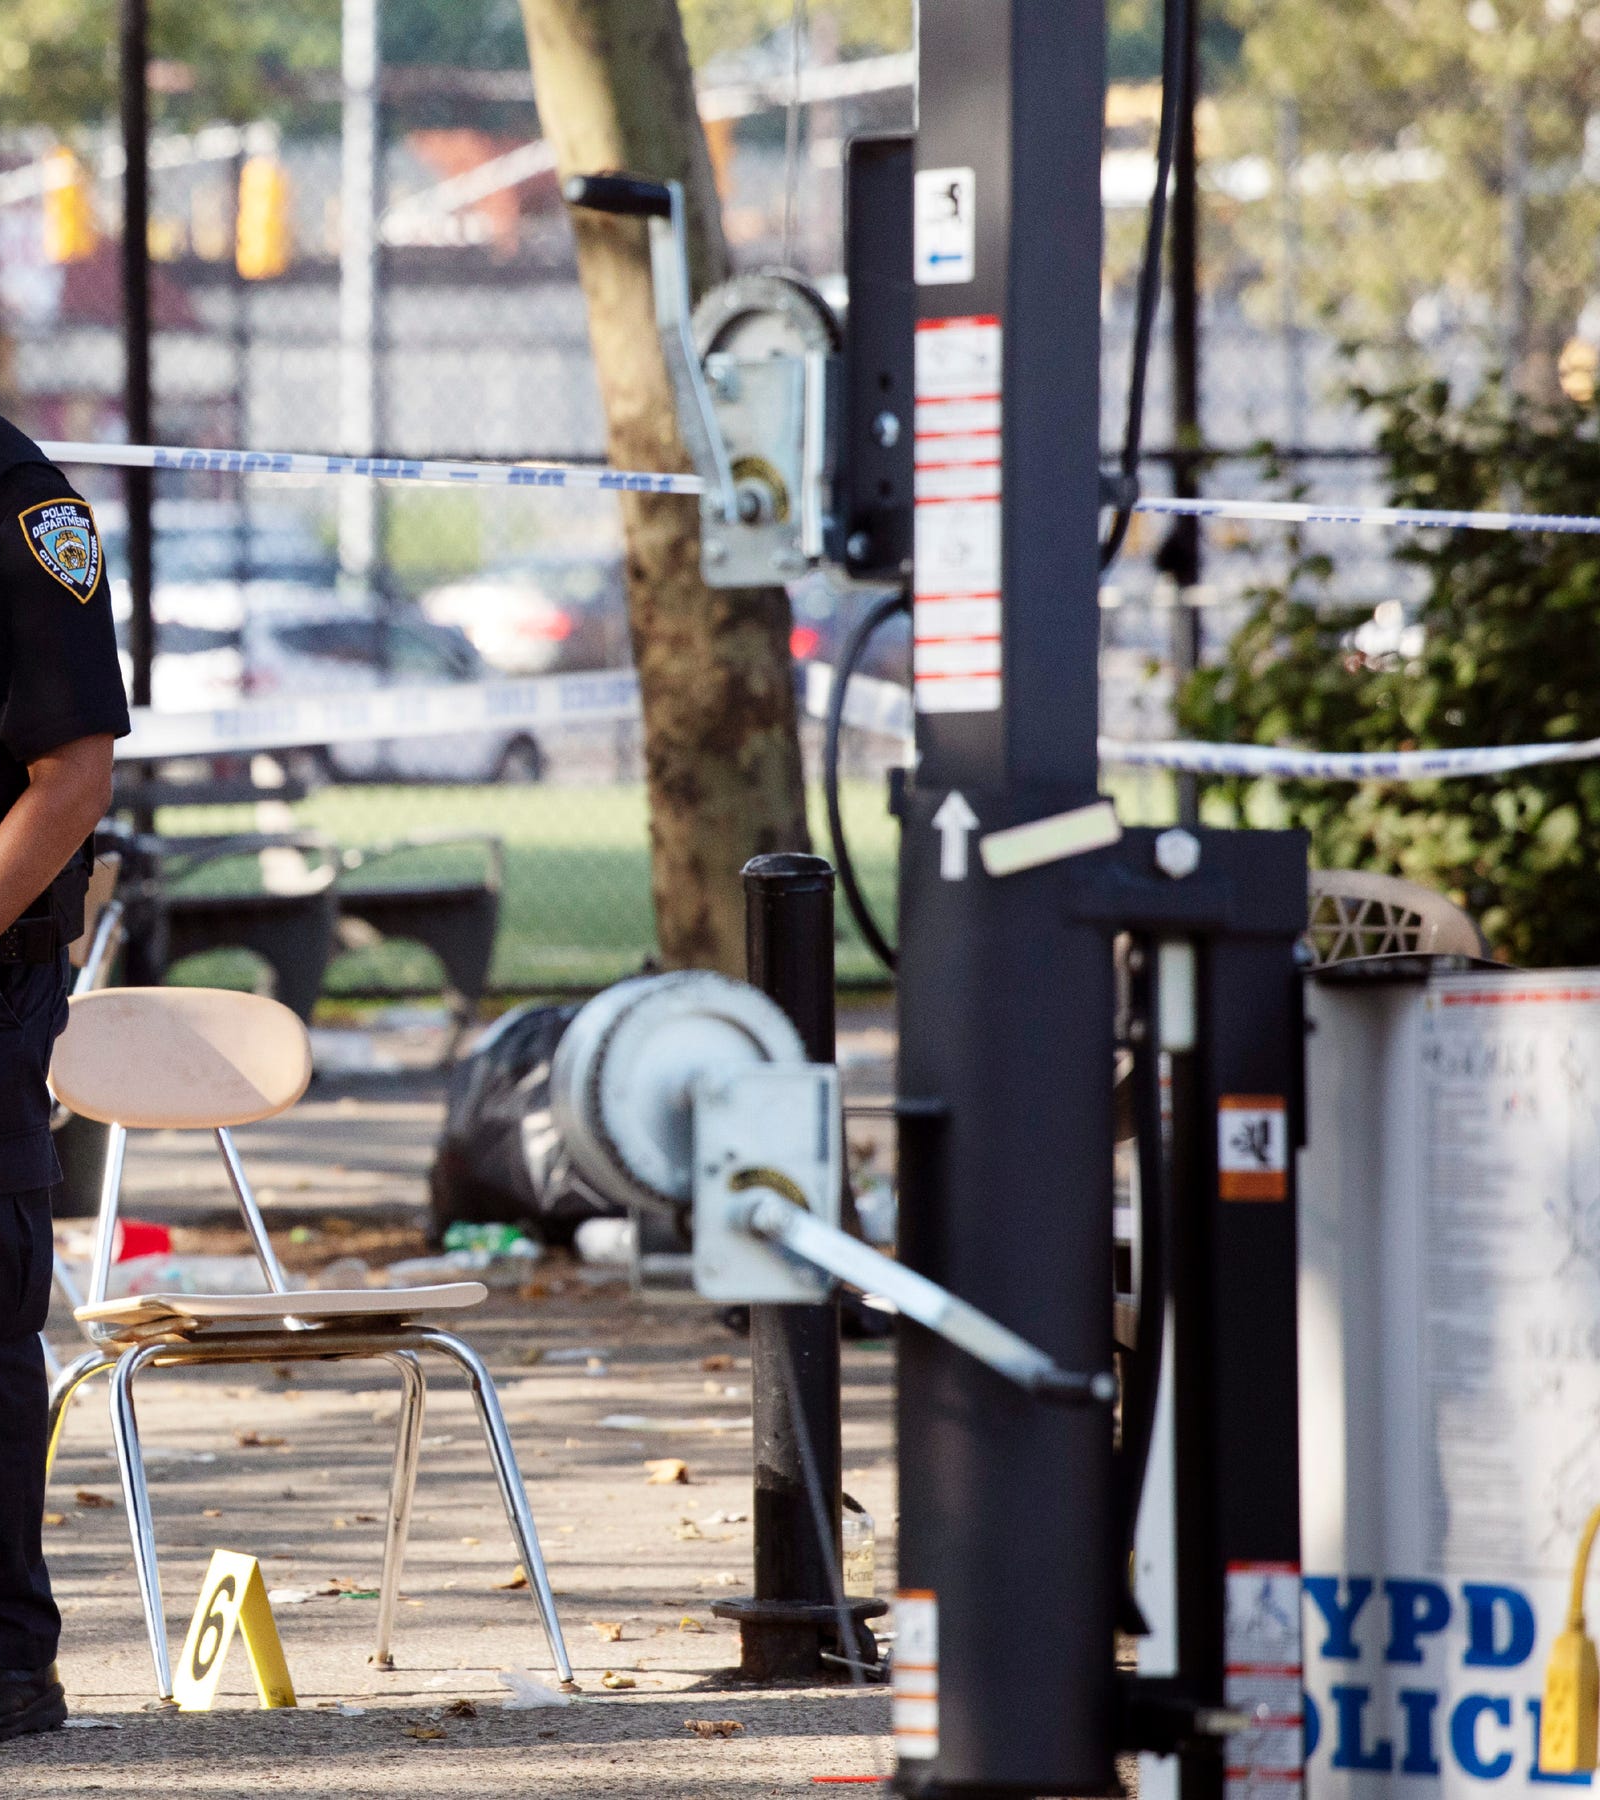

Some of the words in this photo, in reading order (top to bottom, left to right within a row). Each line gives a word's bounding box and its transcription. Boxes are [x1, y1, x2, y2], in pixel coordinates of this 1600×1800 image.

[32, 516, 90, 539] DEPARTMENT
[41, 505, 77, 522] POLICE
[39, 549, 60, 572] CITY
[59, 572, 74, 586] OF
[90, 535, 99, 566] YORK
[85, 566, 97, 588] NEW
[192, 1574, 236, 1681] 6
[1303, 1577, 1536, 1668] YPD
[1304, 1703, 1593, 1785] LIC
